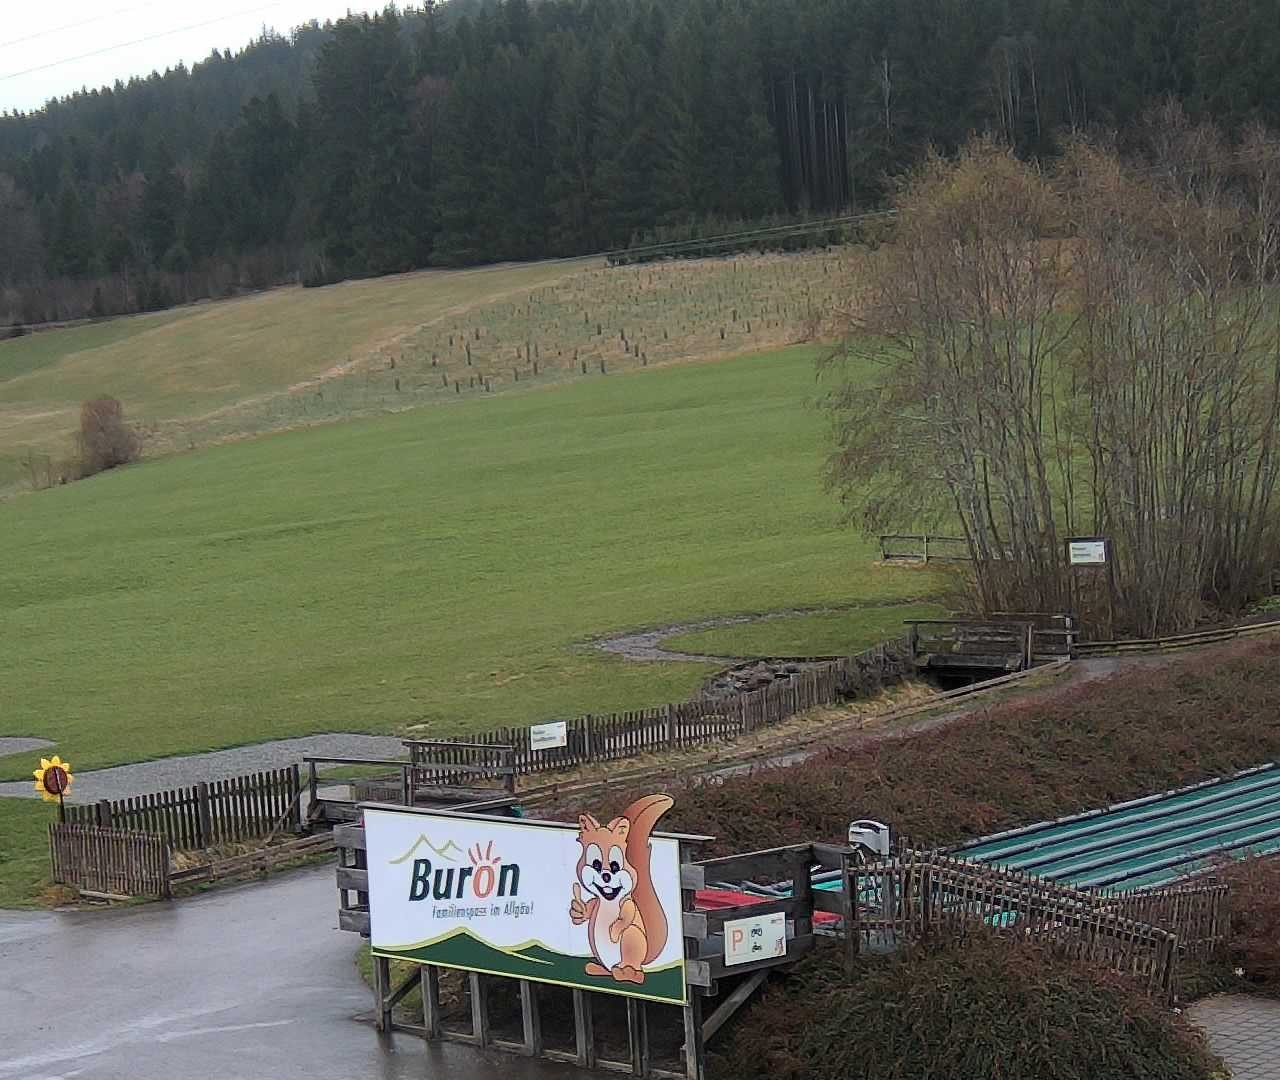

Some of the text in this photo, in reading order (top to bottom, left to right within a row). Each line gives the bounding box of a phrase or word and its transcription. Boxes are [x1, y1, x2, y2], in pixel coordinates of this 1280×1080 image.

[409, 858, 521, 902] Buron
[489, 903, 500, 917] im
[732, 928, 744, 952] P
